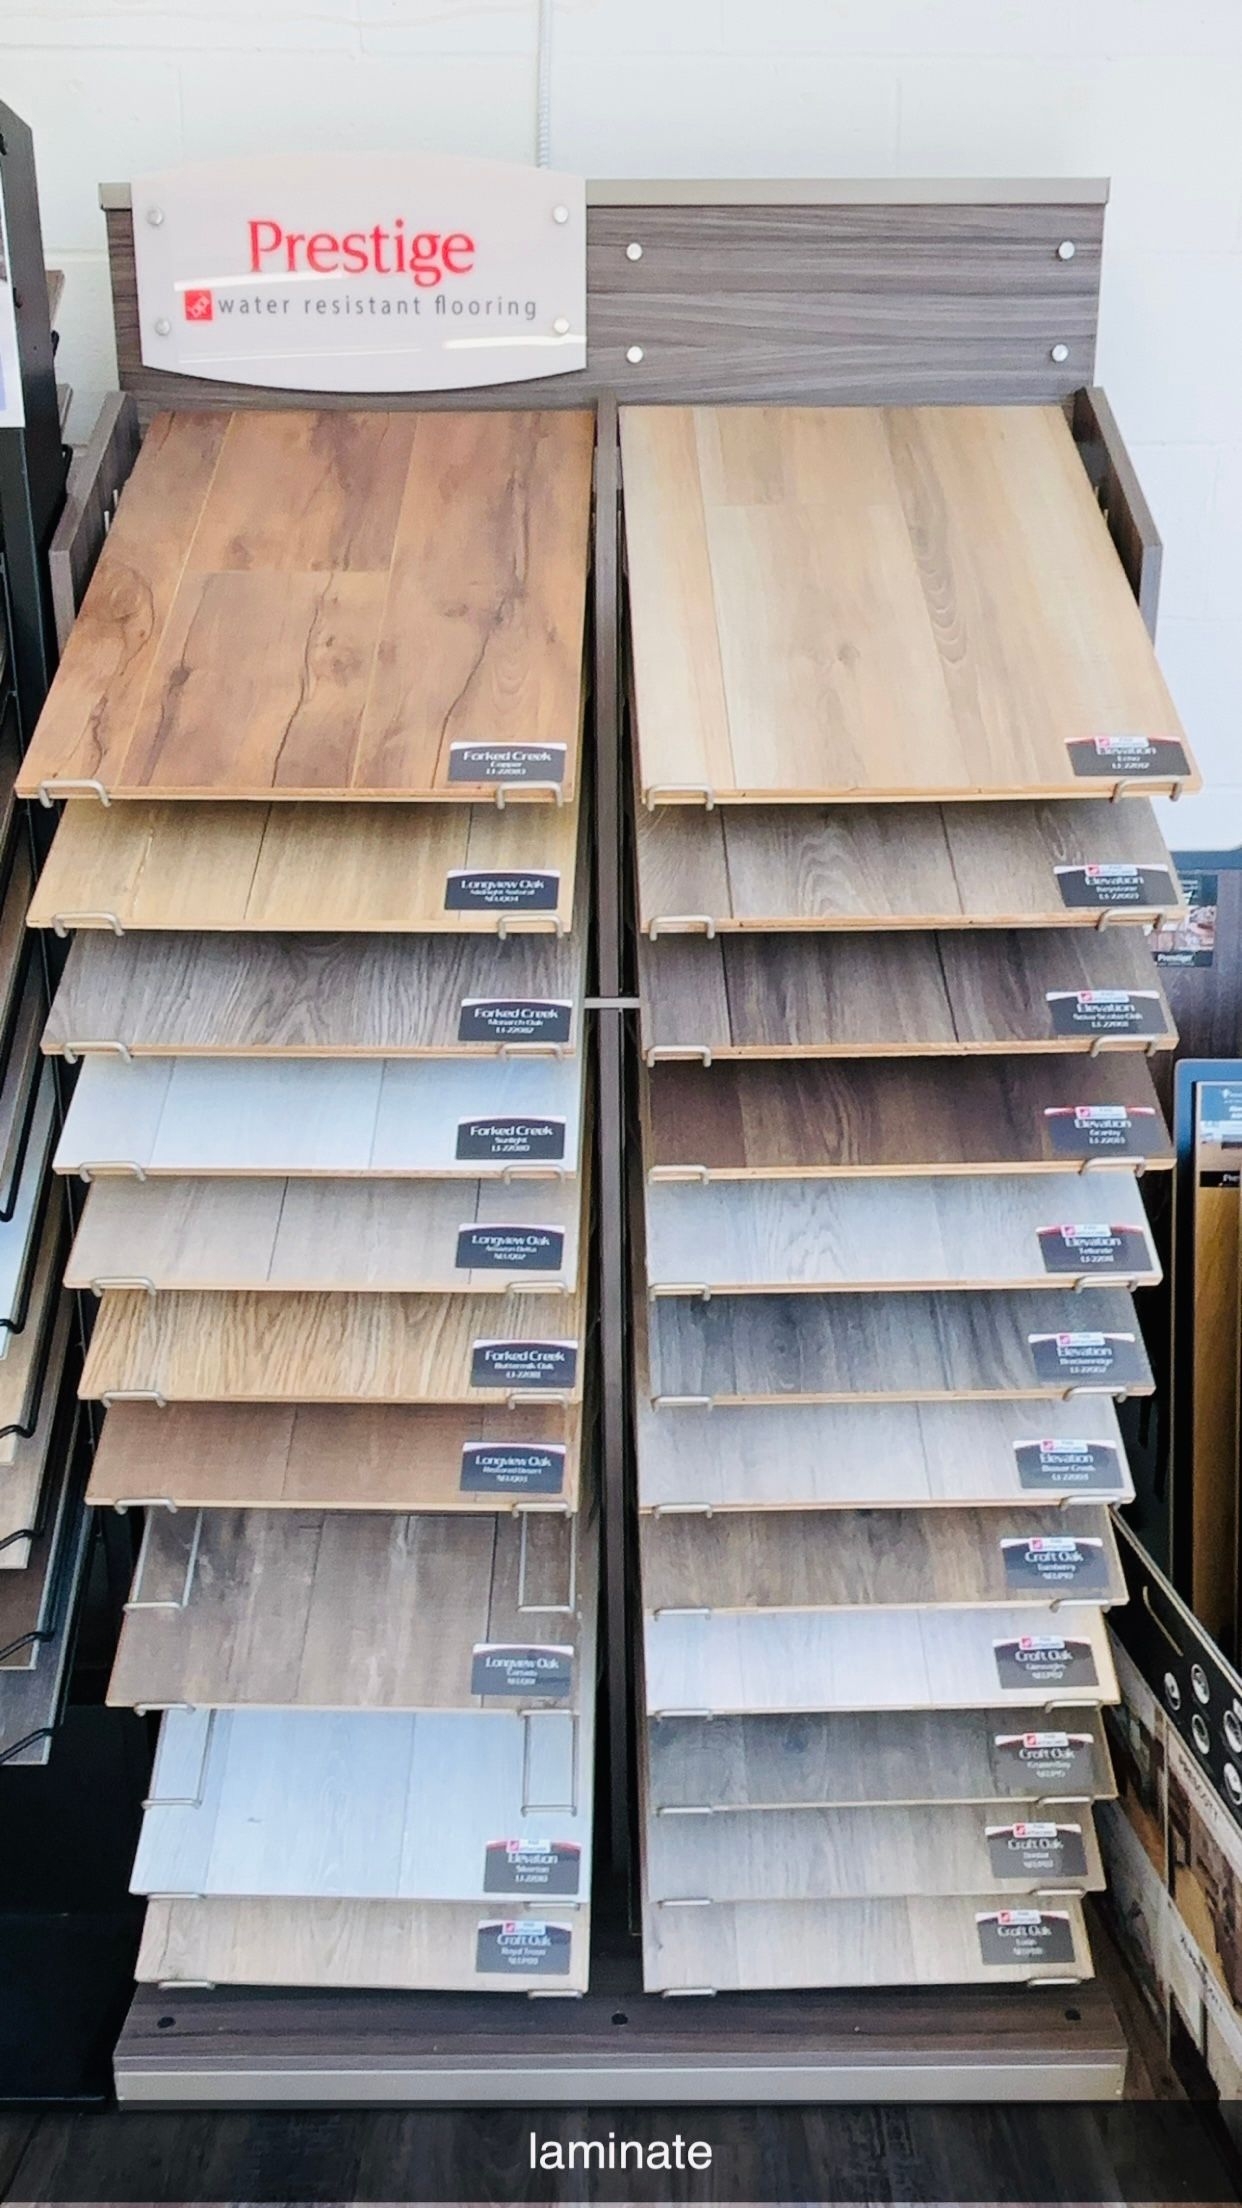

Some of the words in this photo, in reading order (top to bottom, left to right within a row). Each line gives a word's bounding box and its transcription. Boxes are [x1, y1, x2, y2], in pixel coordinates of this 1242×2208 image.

[248, 219, 475, 288] Prestige
[219, 297, 289, 315] water
[305, 295, 421, 315] resistant
[436, 295, 537, 320] flooring
[464, 751, 510, 760] Forked
[512, 751, 551, 760] Creek
[1097, 747, 1156, 755] Elevation
[461, 880, 518, 890] Longview
[519, 880, 544, 889] Oak
[1085, 877, 1144, 885] Elevation
[474, 1008, 519, 1018] Forked
[521, 1009, 558, 1018] Creek
[1076, 1004, 1135, 1012] Elevation
[1074, 1120, 1132, 1128] Elevation
[470, 1126, 514, 1136] Forked
[516, 1126, 553, 1135] Creek
[472, 1235, 524, 1246] Longview
[526, 1236, 550, 1245] Oak
[1065, 1238, 1121, 1246] Elevation
[485, 1351, 528, 1360] Forked
[529, 1351, 565, 1361] Creek
[1057, 1347, 1113, 1356] Elevation
[475, 1456, 526, 1468] Longview
[528, 1456, 551, 1466] Oak
[1041, 1454, 1093, 1463] Elevation
[1024, 1552, 1057, 1562] Croft
[1059, 1552, 1084, 1561] Oak
[1015, 1651, 1047, 1661] Croft
[1048, 1651, 1073, 1660] Oak
[485, 1656, 535, 1670] Longview
[537, 1658, 559, 1668] Oak
[1019, 1749, 1049, 1759] Croft
[1051, 1749, 1075, 1759] Oak
[1040, 1839, 1064, 1849] Oak
[508, 1854, 558, 1863] Elevation
[1028, 1925, 1052, 1936] Oak
[497, 1934, 527, 1946] Croft
[528, 1935, 551, 1946] Oak
